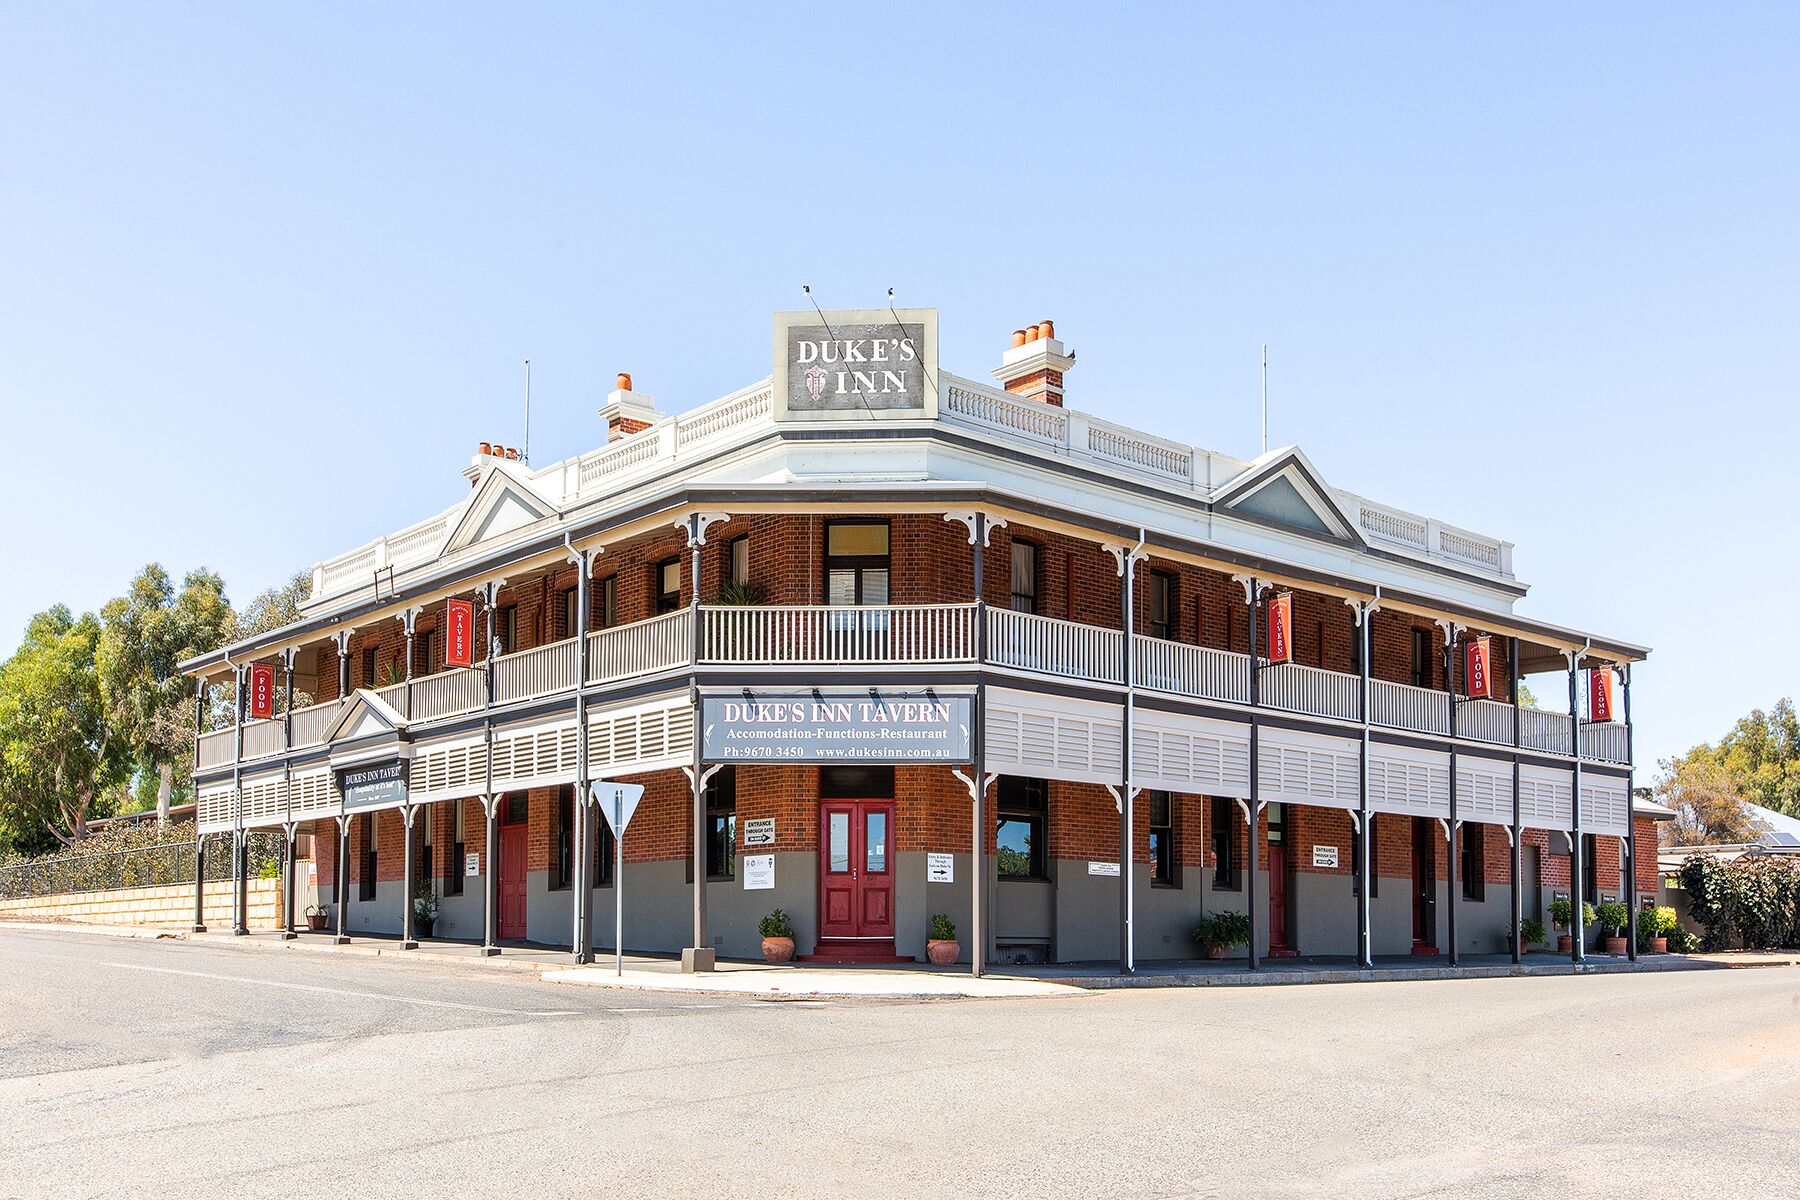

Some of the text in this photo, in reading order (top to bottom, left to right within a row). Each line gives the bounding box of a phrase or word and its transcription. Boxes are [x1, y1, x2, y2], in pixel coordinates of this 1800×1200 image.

[797, 338, 915, 363] DUKE'S
[835, 370, 907, 394] INN
[723, 702, 951, 723] DUKE'S INN TAVERN
[726, 728, 948, 739] Accomodation-Functions-Restaurant
[724, 746, 950, 757] Ph:9670 3450 www.dukesinn.com.au
[367, 770, 378, 781] INN
[748, 820, 771, 828] ENTRANCE
